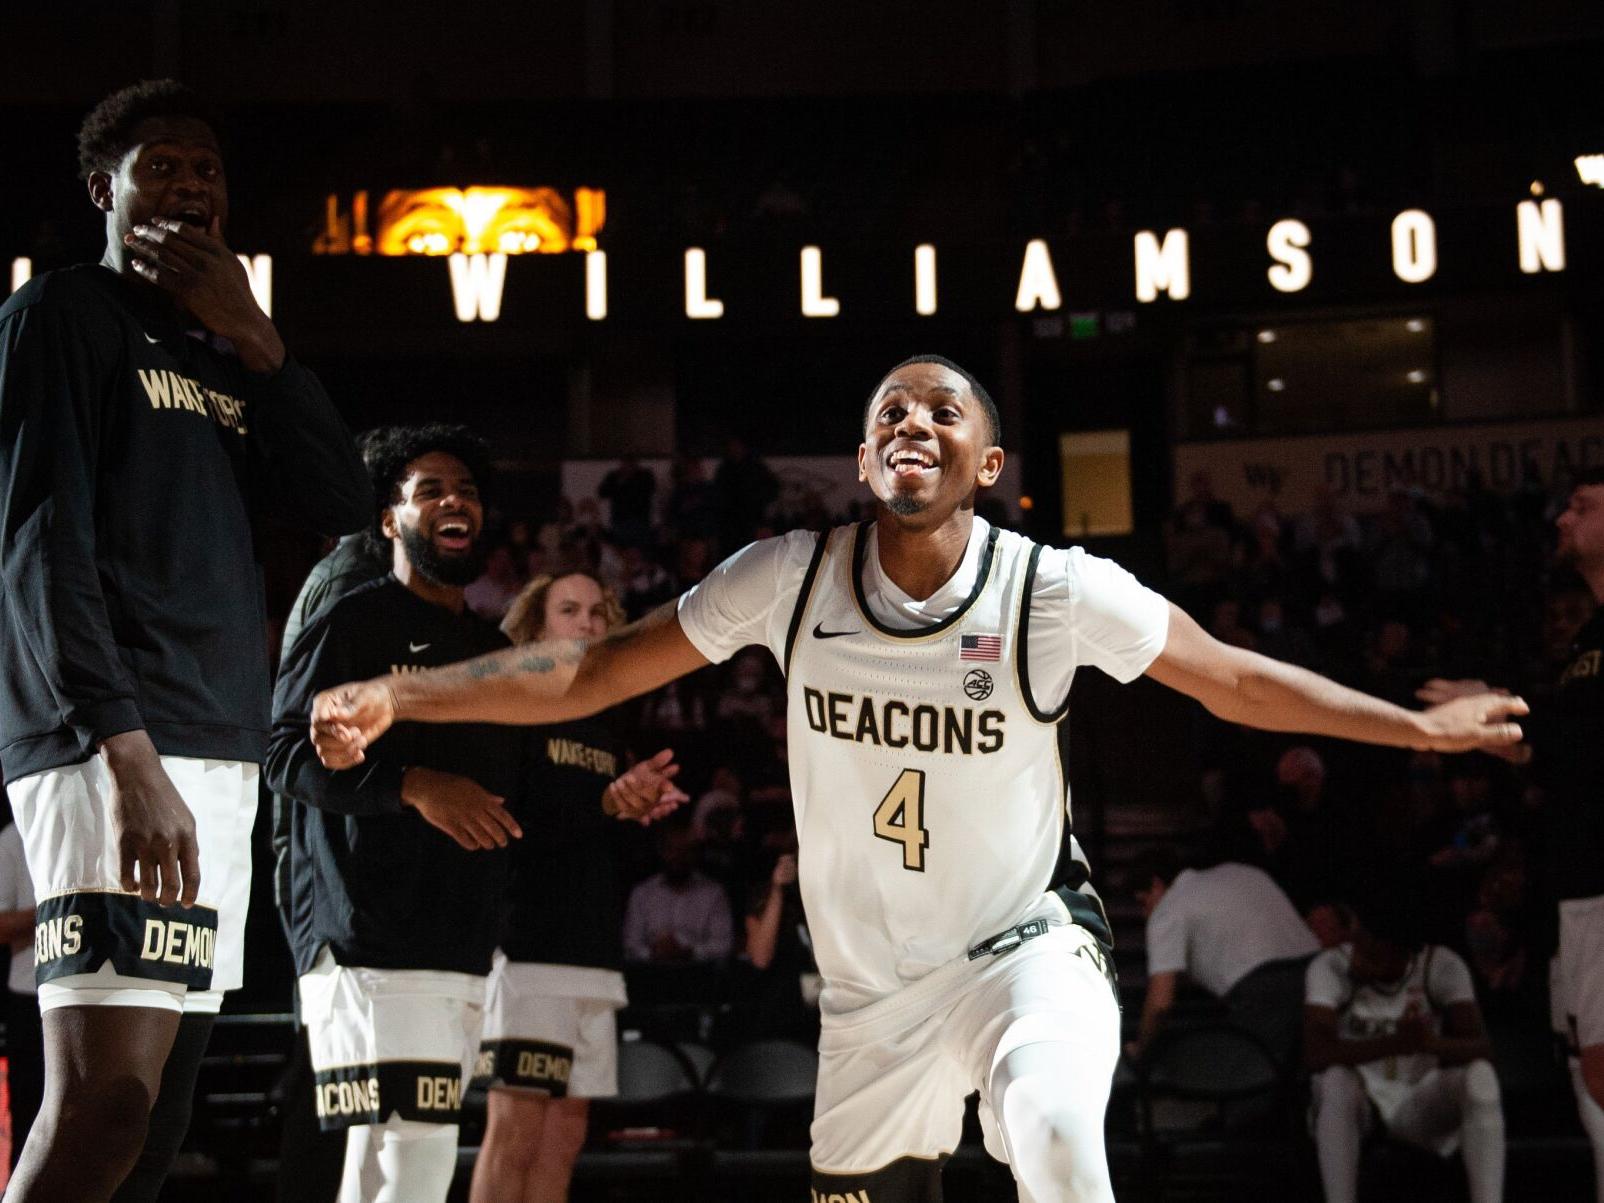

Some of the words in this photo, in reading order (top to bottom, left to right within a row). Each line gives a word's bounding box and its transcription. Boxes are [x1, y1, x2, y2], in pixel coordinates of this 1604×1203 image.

[446, 197, 1567, 323] WILLIAMSON
[964, 679, 993, 690] ACC
[803, 686, 1006, 754] DEACONS
[872, 767, 930, 873] 4
[1022, 925, 1038, 935] 46
